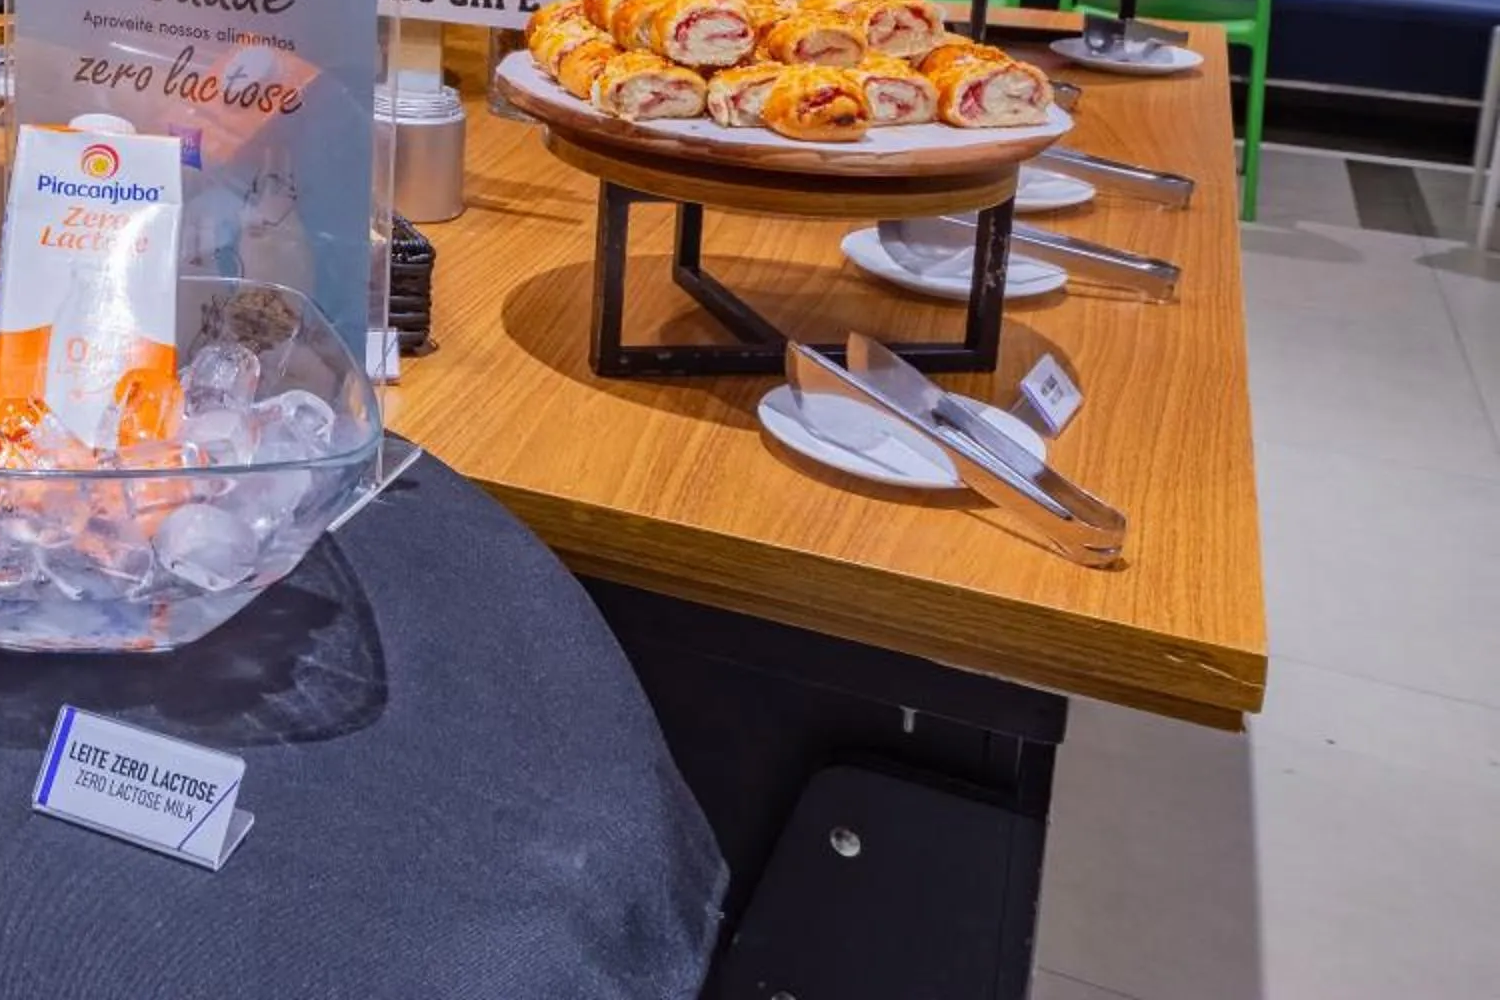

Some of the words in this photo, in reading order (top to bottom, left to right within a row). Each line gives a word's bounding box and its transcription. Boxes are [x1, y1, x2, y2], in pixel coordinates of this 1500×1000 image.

[83, 10, 153, 34] Aproveite
[158, 23, 211, 40] nossos
[217, 28, 296, 51] alimentos
[74, 56, 154, 92] zero
[163, 45, 303, 115] lactose
[38, 174, 160, 204] Piracanjuba
[69, 741, 111, 770] LEITE
[111, 752, 149, 782] ZERO
[151, 764, 218, 805] LACTOSE
[75, 769, 107, 794] ZERO
[109, 779, 163, 811] LACTOSE
[163, 797, 197, 823] MILK
